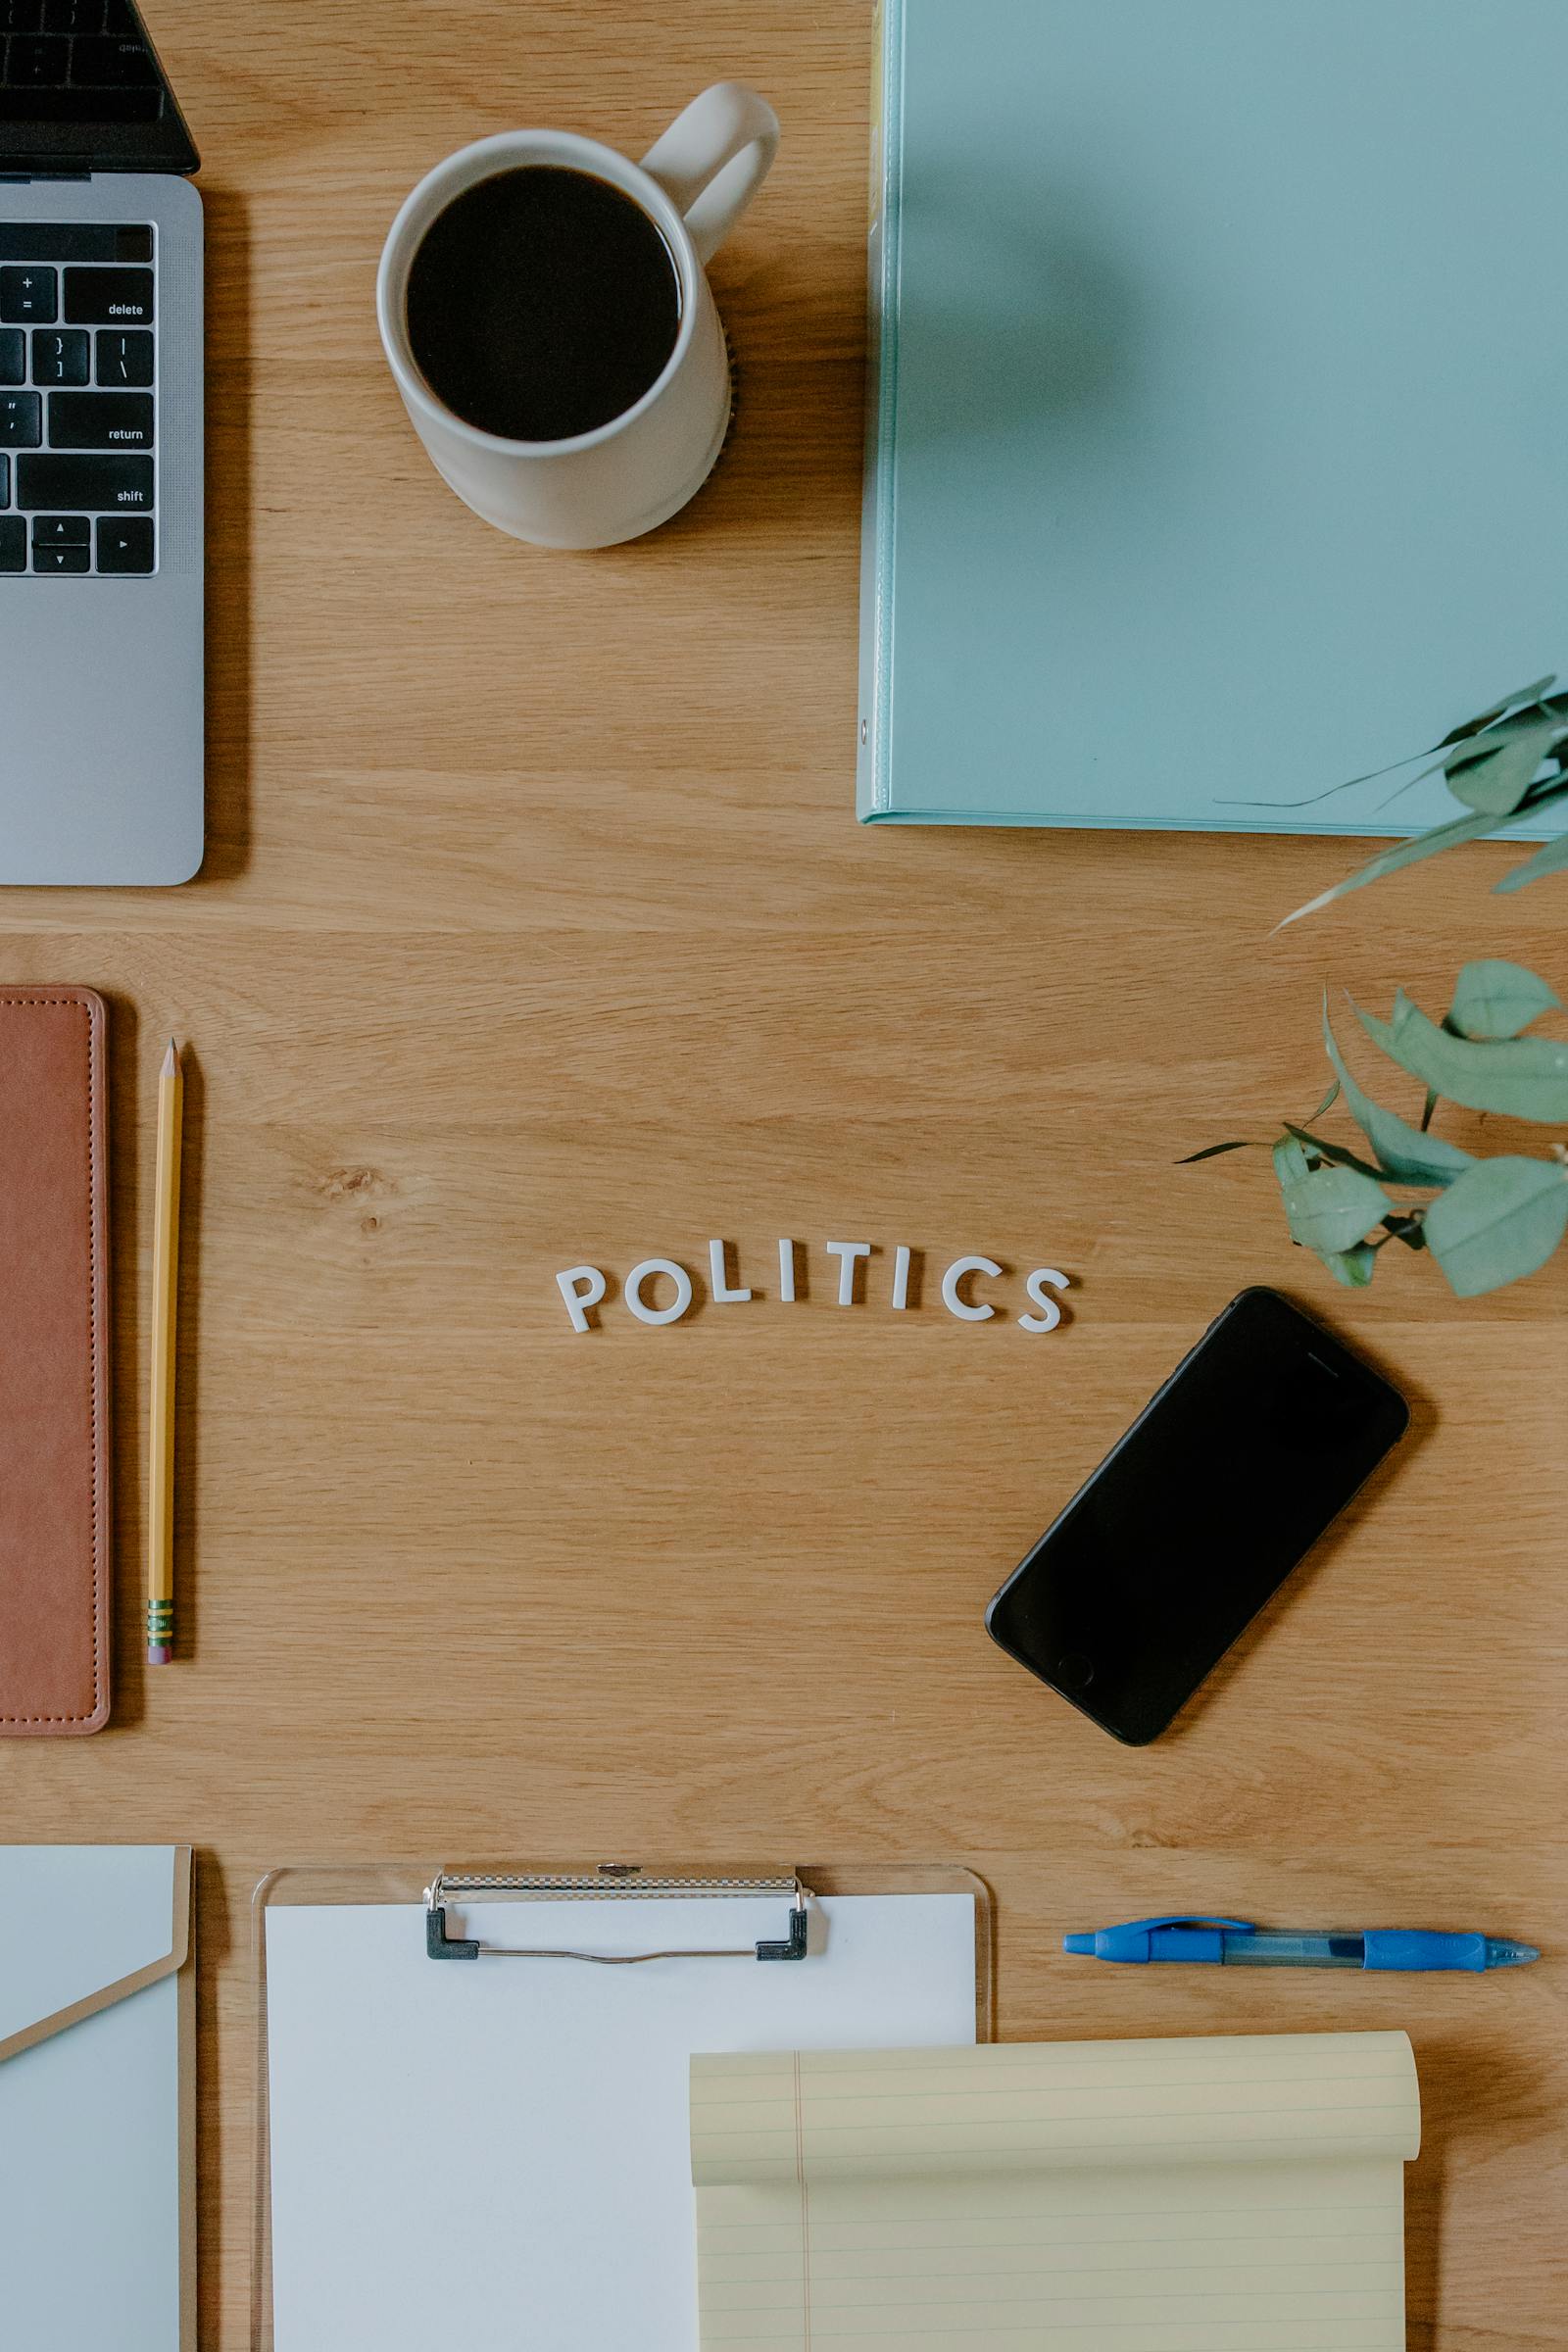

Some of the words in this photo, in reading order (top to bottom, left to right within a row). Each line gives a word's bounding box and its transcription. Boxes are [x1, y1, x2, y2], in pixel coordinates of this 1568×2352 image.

[109, 304, 143, 315] delete
[109, 430, 143, 440] return
[117, 491, 144, 502] shift
[556, 1239, 1070, 1334] POLITICS
